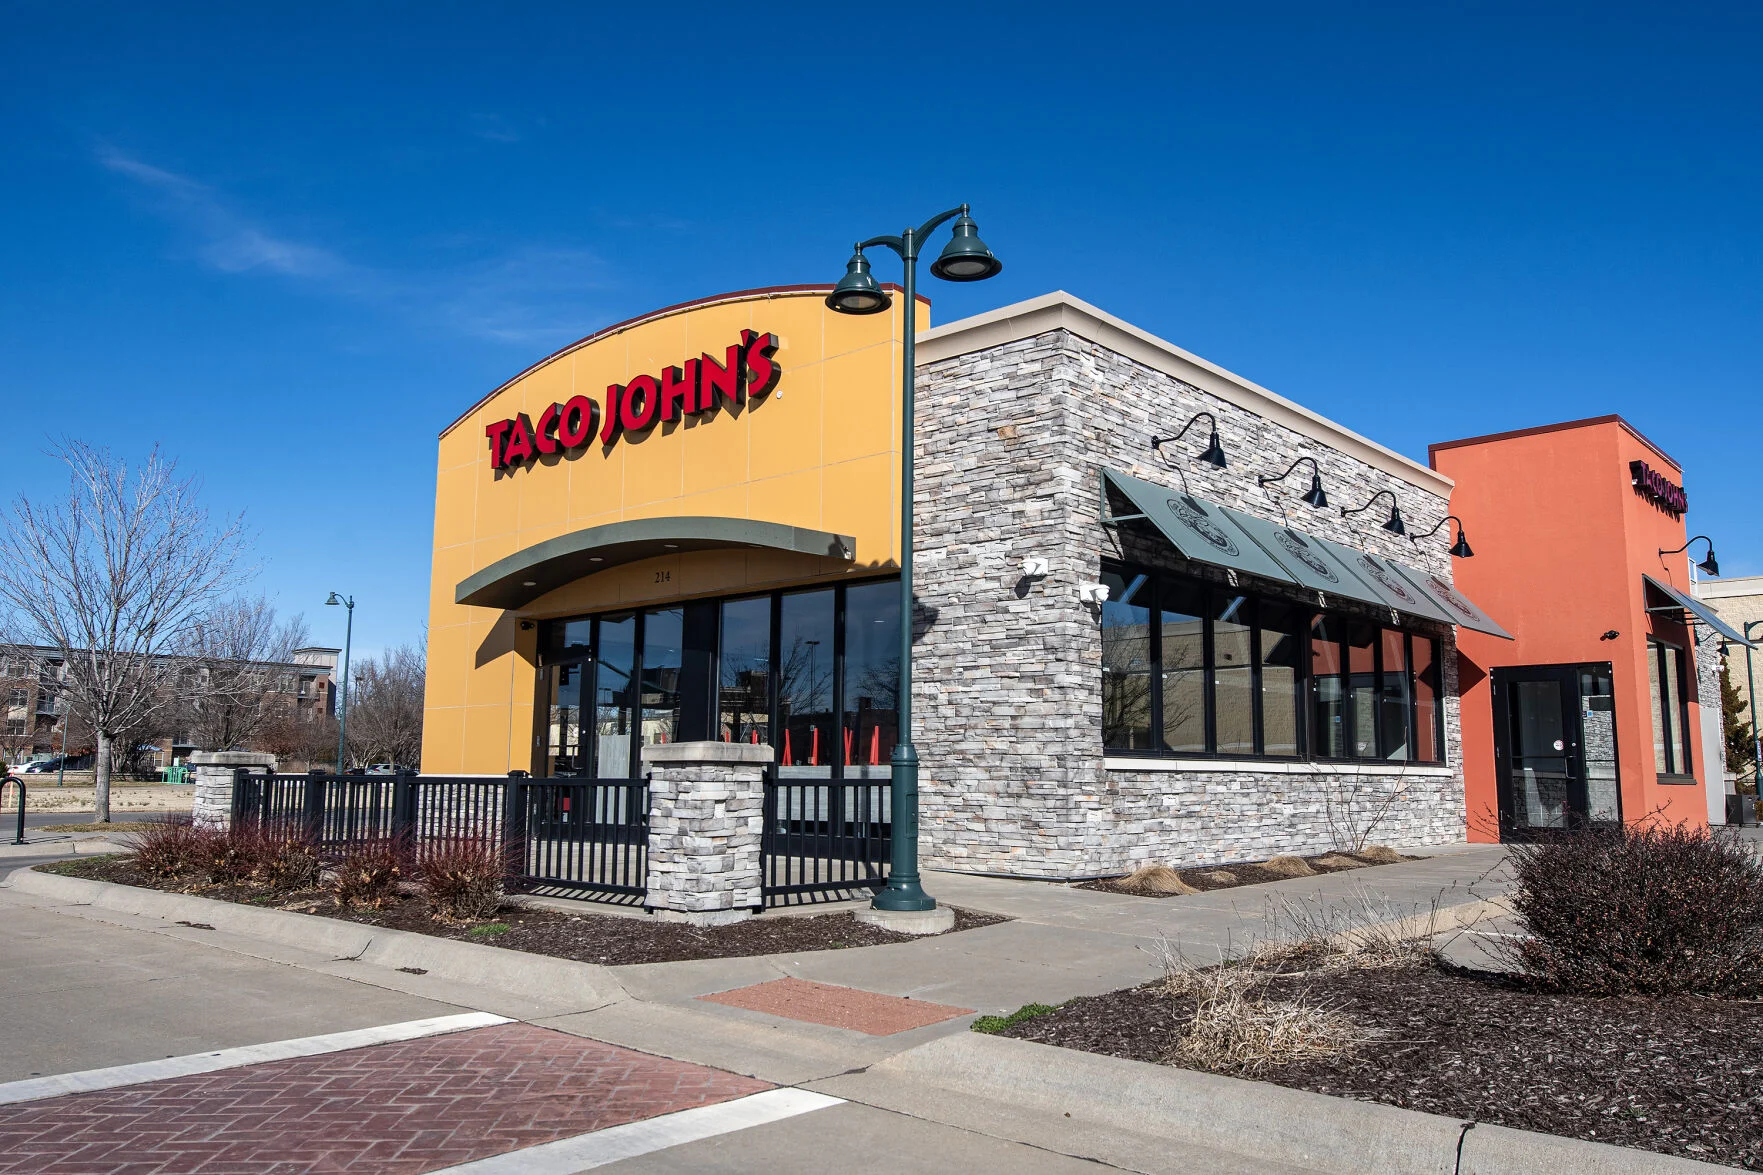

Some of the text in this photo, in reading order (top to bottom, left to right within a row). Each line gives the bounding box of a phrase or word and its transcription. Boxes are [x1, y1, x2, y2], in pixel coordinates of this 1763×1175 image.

[486, 329, 779, 469] TACO JOHN'S
[654, 570, 671, 584] 214
